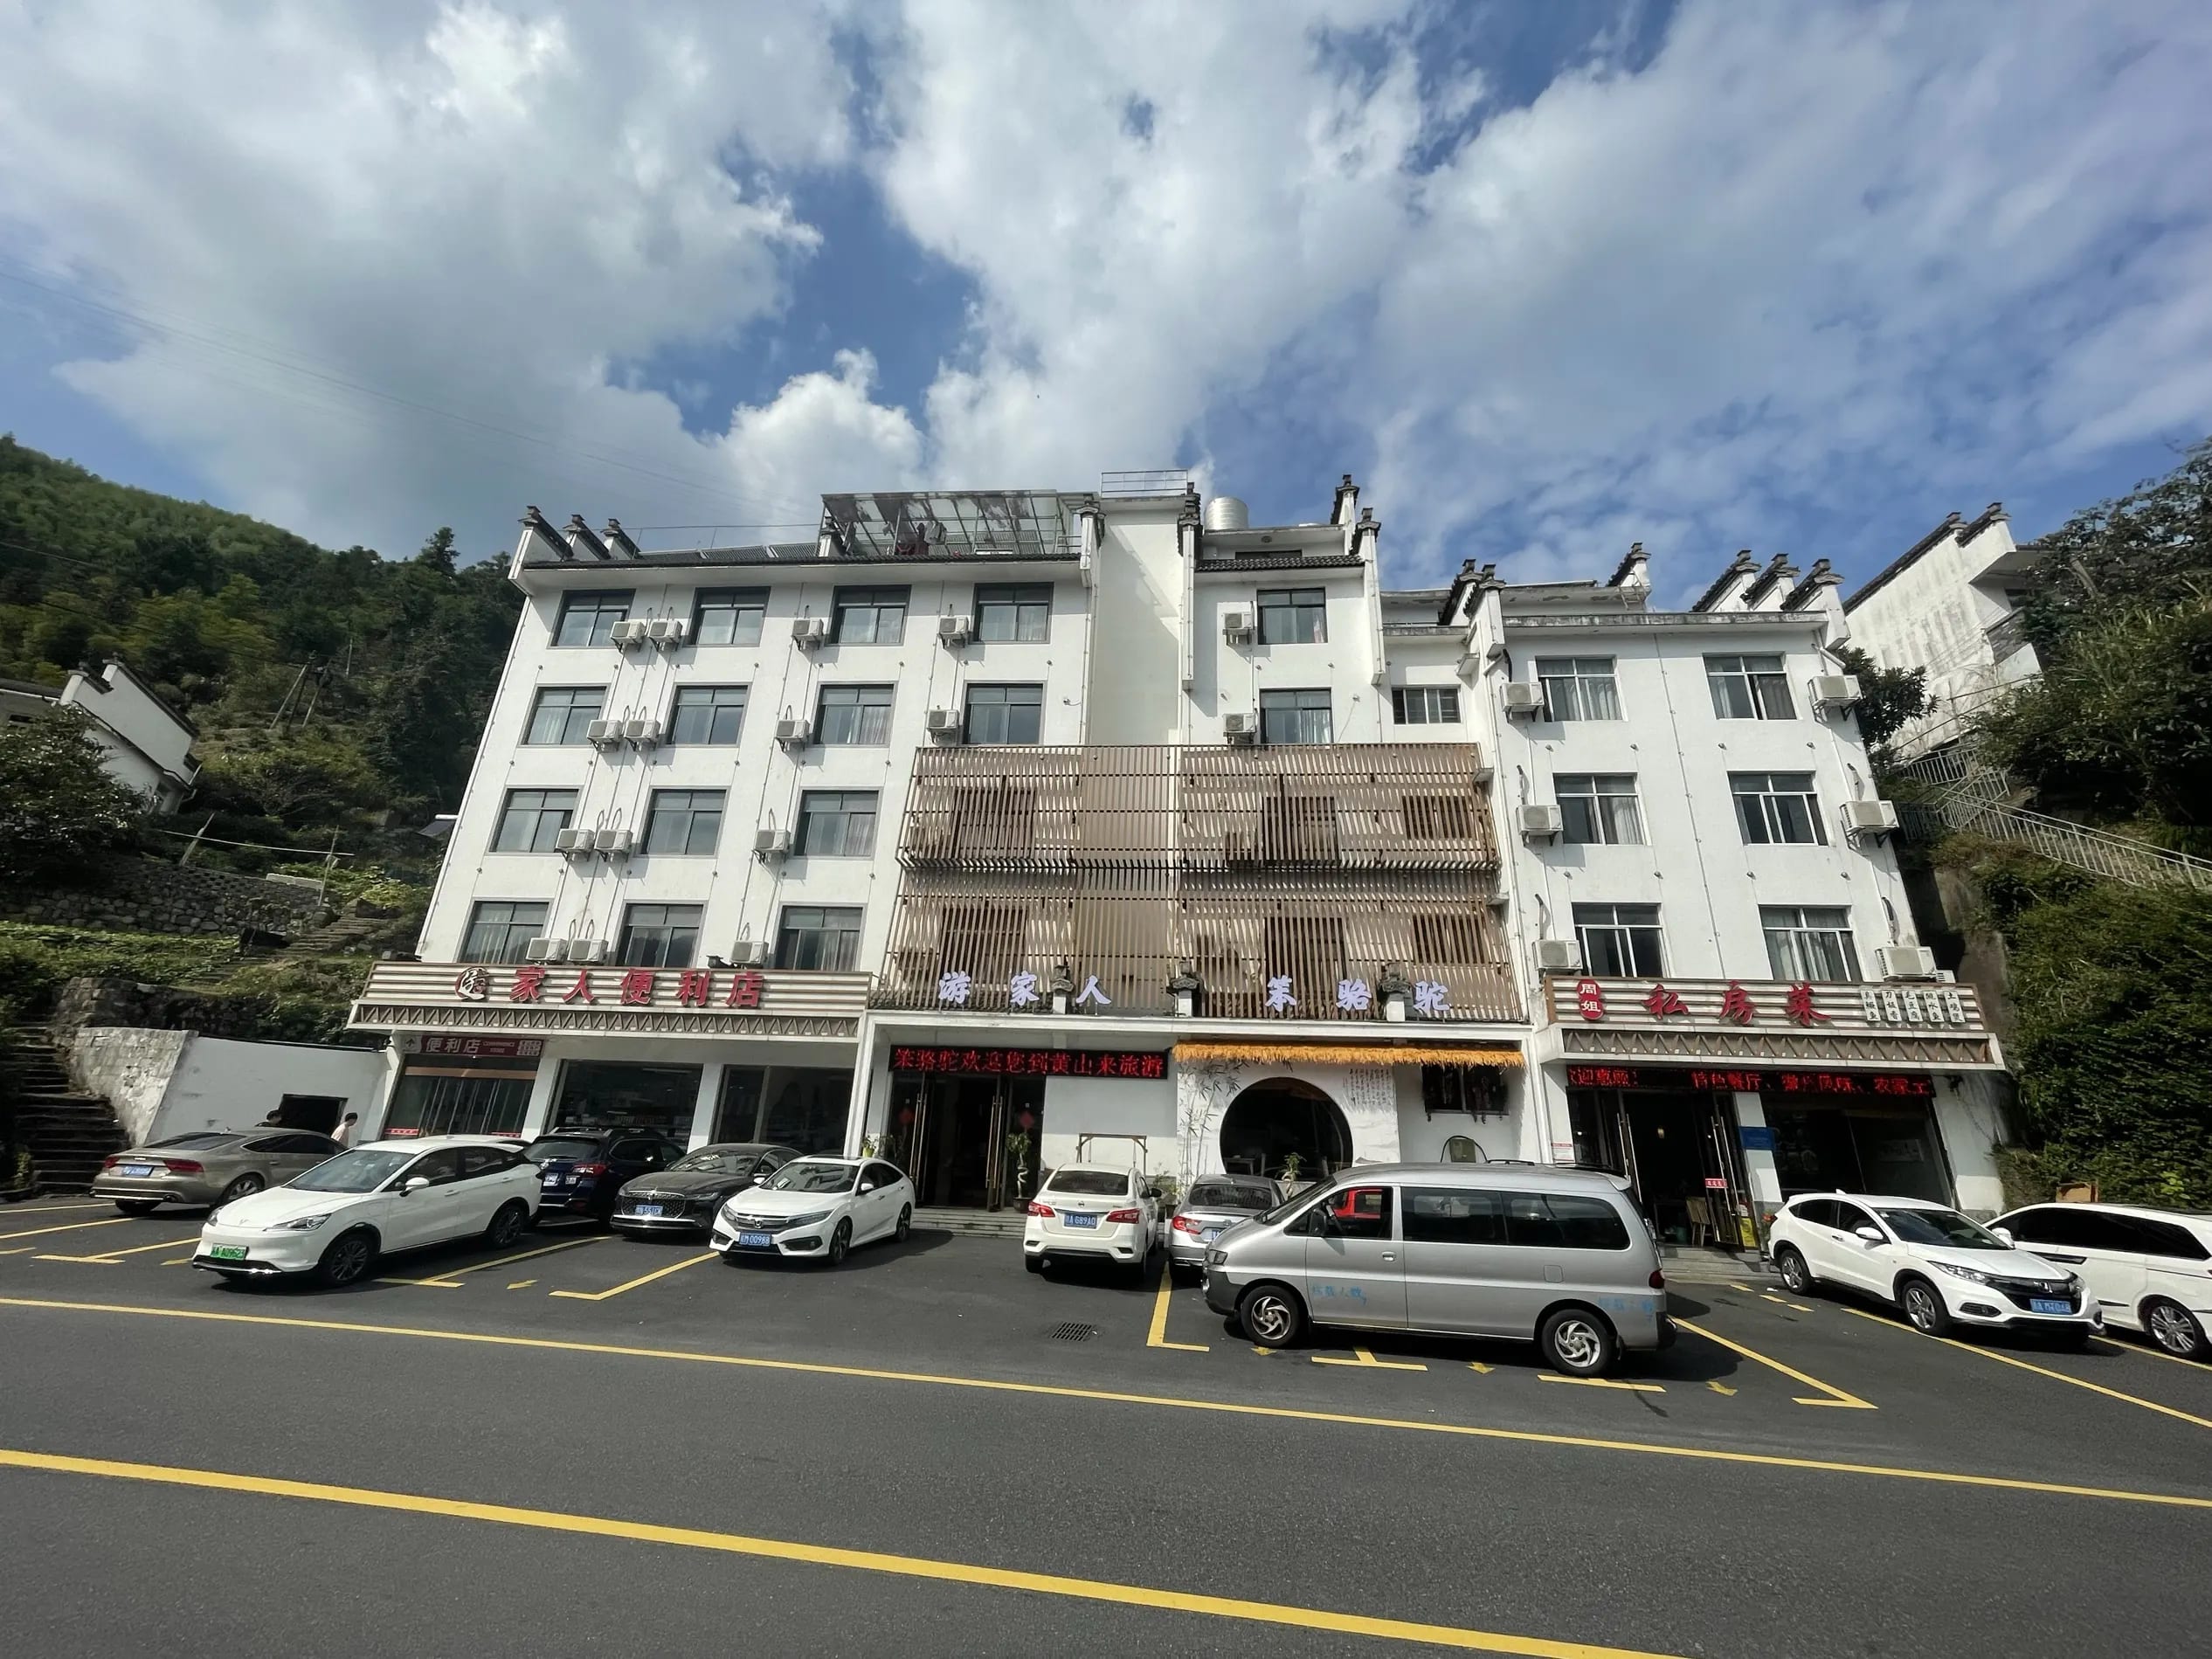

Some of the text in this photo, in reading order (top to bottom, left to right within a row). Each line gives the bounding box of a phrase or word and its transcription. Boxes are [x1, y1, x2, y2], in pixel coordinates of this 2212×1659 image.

[938, 971, 1450, 1013] 游家人 笨骆驼
[1580, 983, 1601, 1013] 周姐
[1641, 979, 1832, 1027] 私房菜
[1904, 991, 1920, 1021] 毛豆腐
[425, 1037, 480, 1054] 便利店
[894, 1048, 1165, 1078] 笨骆驼欢迎您到黄山来旅游
